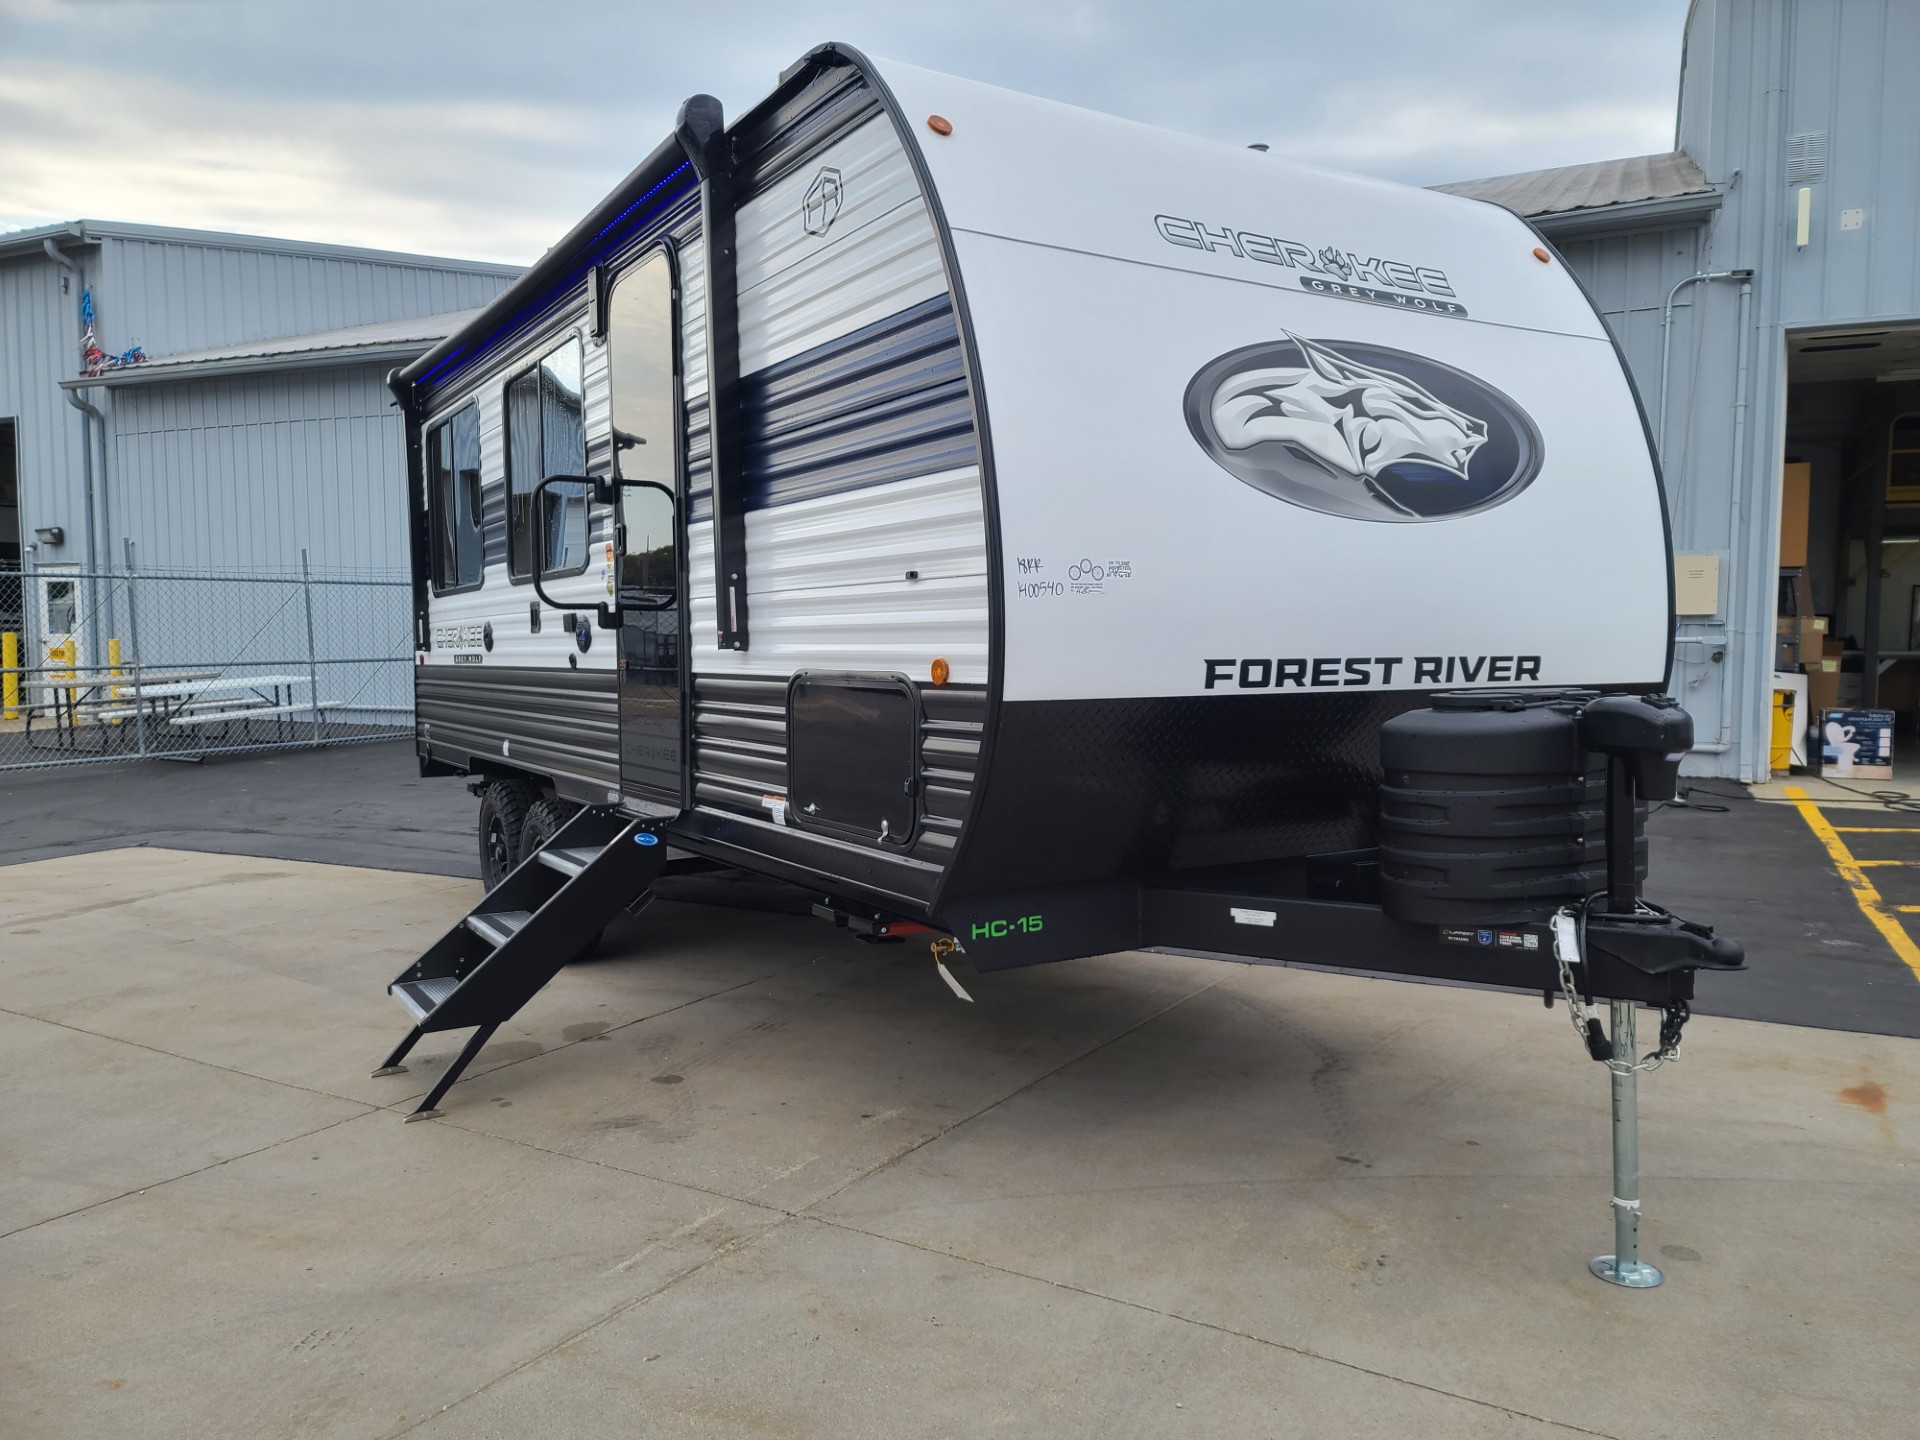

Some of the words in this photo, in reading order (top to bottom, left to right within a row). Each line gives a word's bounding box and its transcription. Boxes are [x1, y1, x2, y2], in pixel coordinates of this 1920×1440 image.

[1311, 279, 1377, 301] GREY
[1393, 294, 1458, 314] WOLF
[455, 655, 467, 663] GREY
[468, 655, 482, 663] WOLF
[1203, 656, 1404, 689] FOREST
[1413, 655, 1542, 684] RIVER
[971, 915, 1043, 940] HC-15
